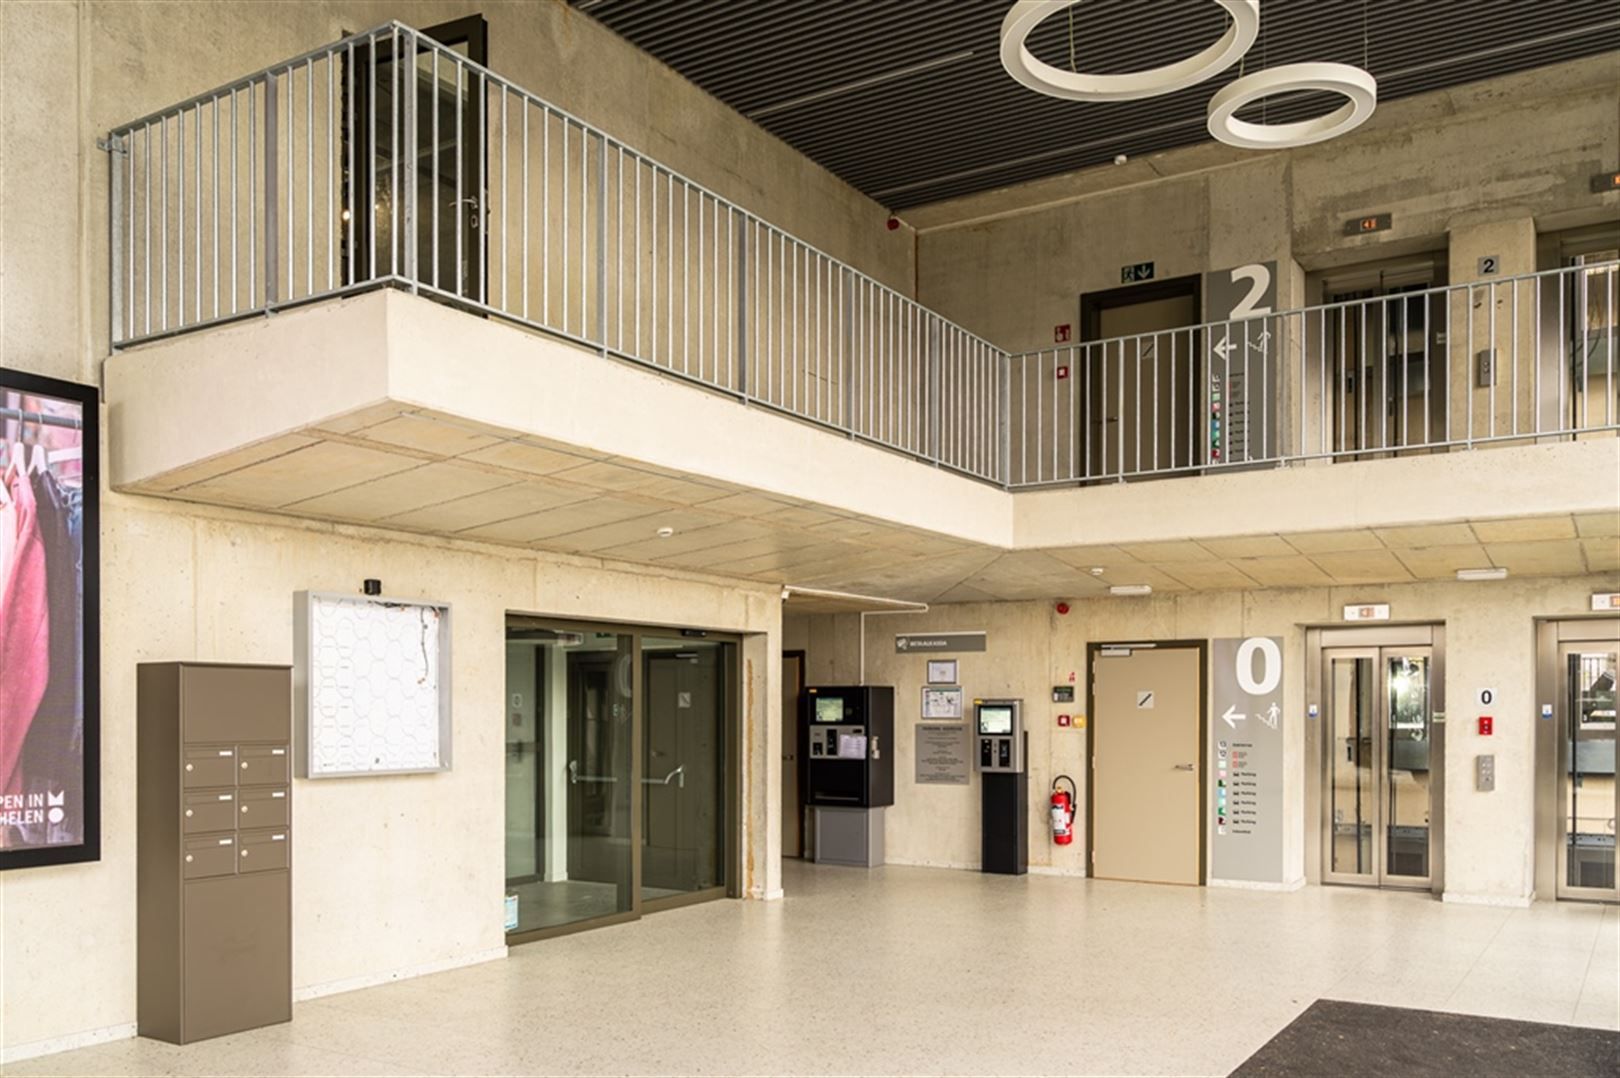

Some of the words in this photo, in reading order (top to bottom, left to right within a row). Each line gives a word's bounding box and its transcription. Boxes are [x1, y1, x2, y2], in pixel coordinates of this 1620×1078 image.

[1484, 258, 1495, 273] 2
[1230, 263, 1271, 320] 2
[1236, 637, 1281, 695] 0
[1481, 690, 1492, 705] 0
[28, 793, 44, 808] IN
